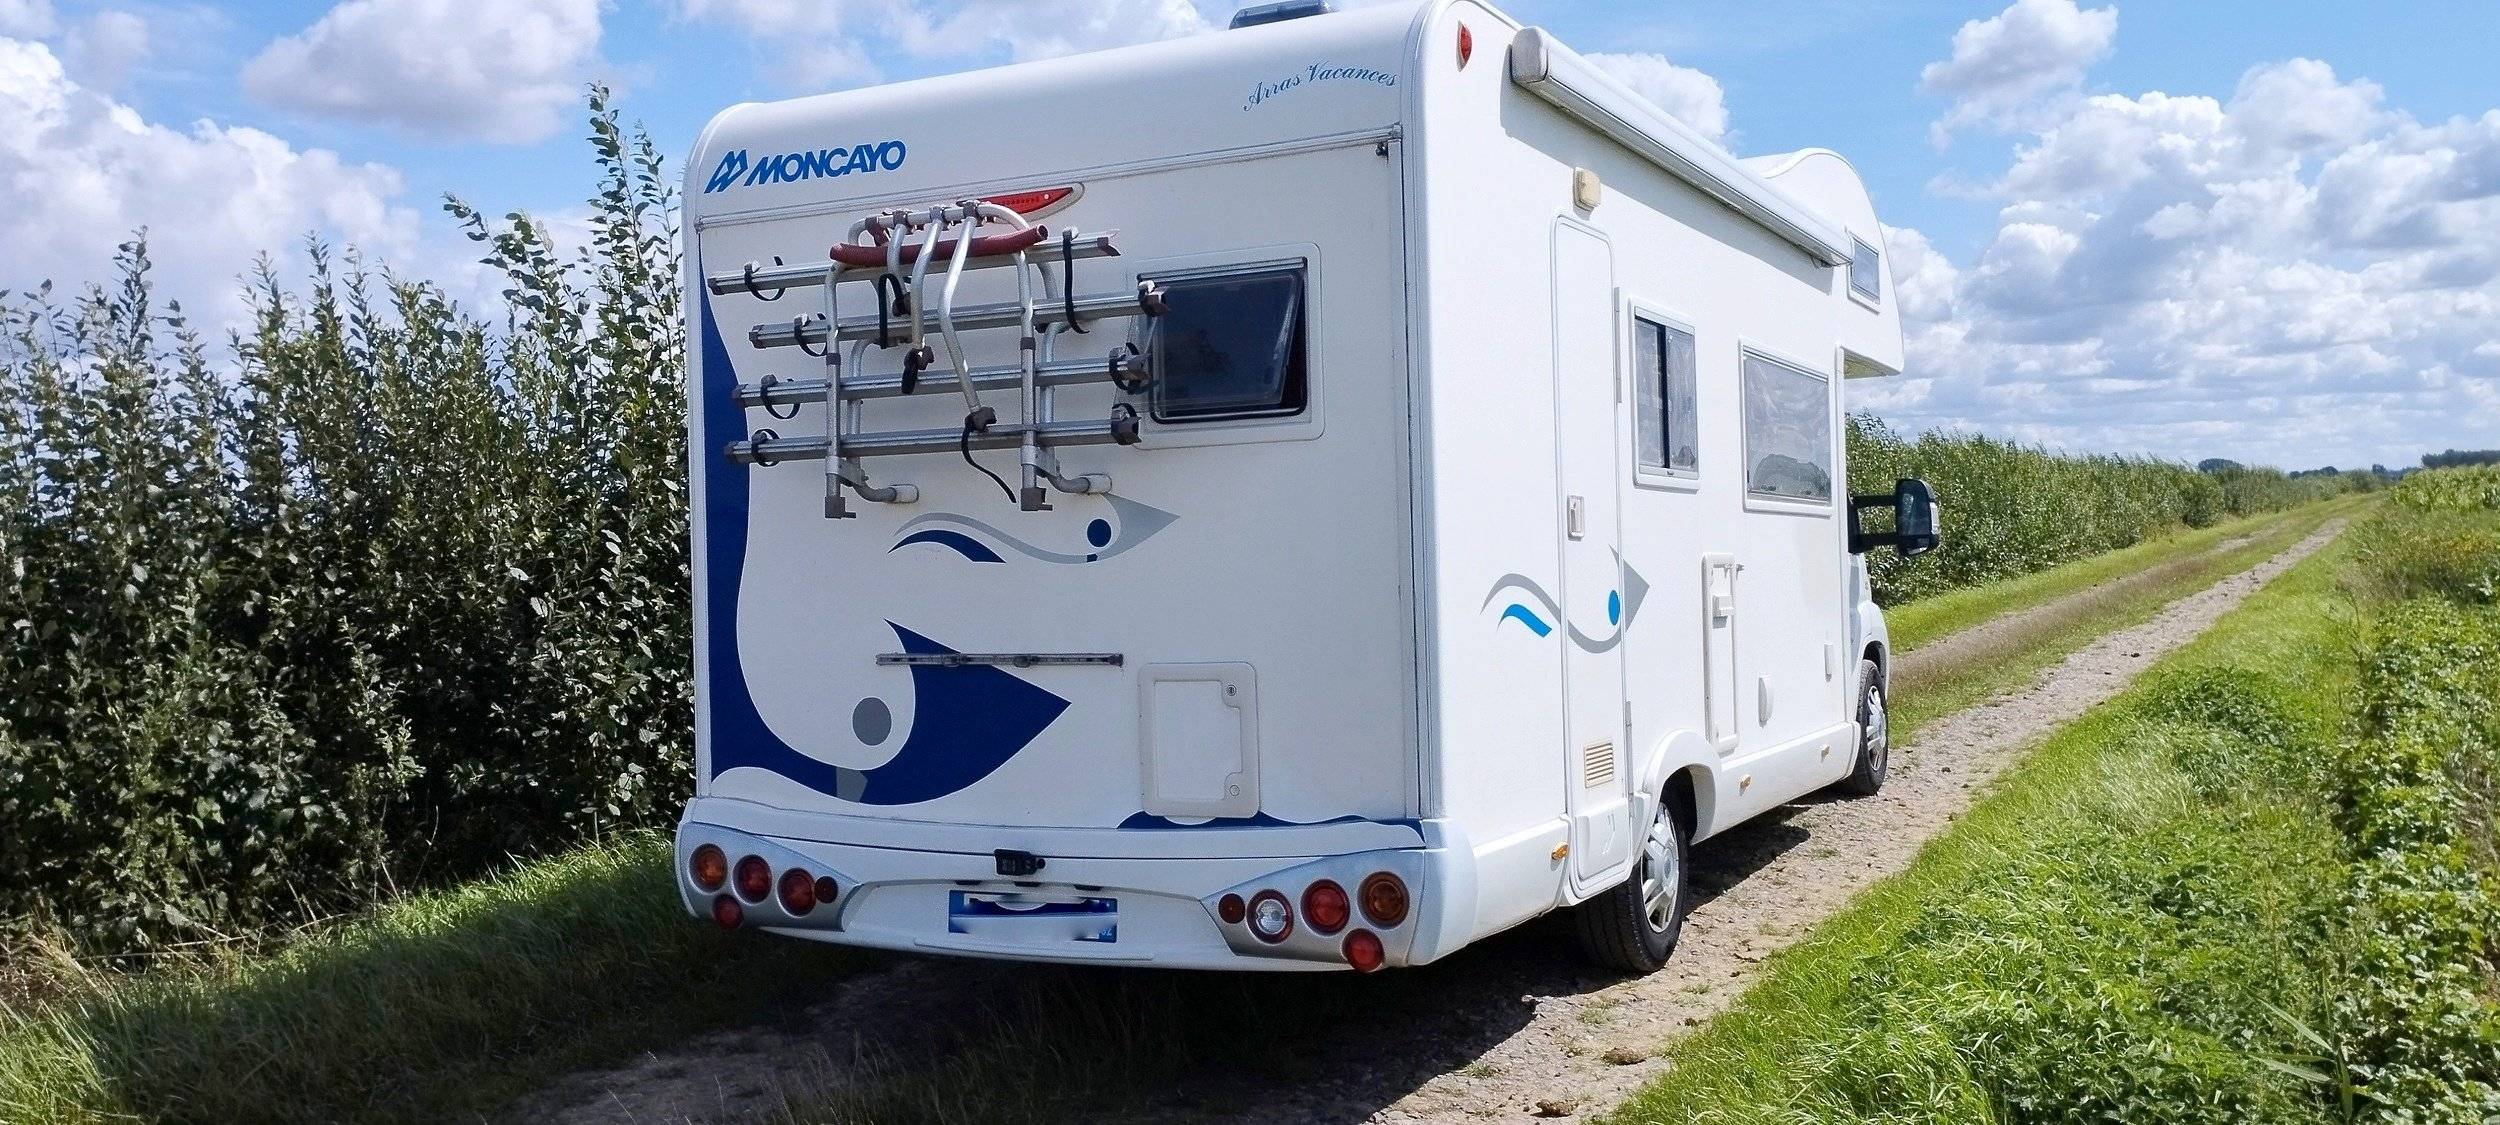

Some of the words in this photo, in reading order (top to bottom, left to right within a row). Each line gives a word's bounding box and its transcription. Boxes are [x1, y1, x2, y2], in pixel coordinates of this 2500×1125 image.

[1242, 75, 1301, 112] Arras
[1305, 60, 1397, 87] Vacances
[743, 140, 906, 187] MONCAYO
